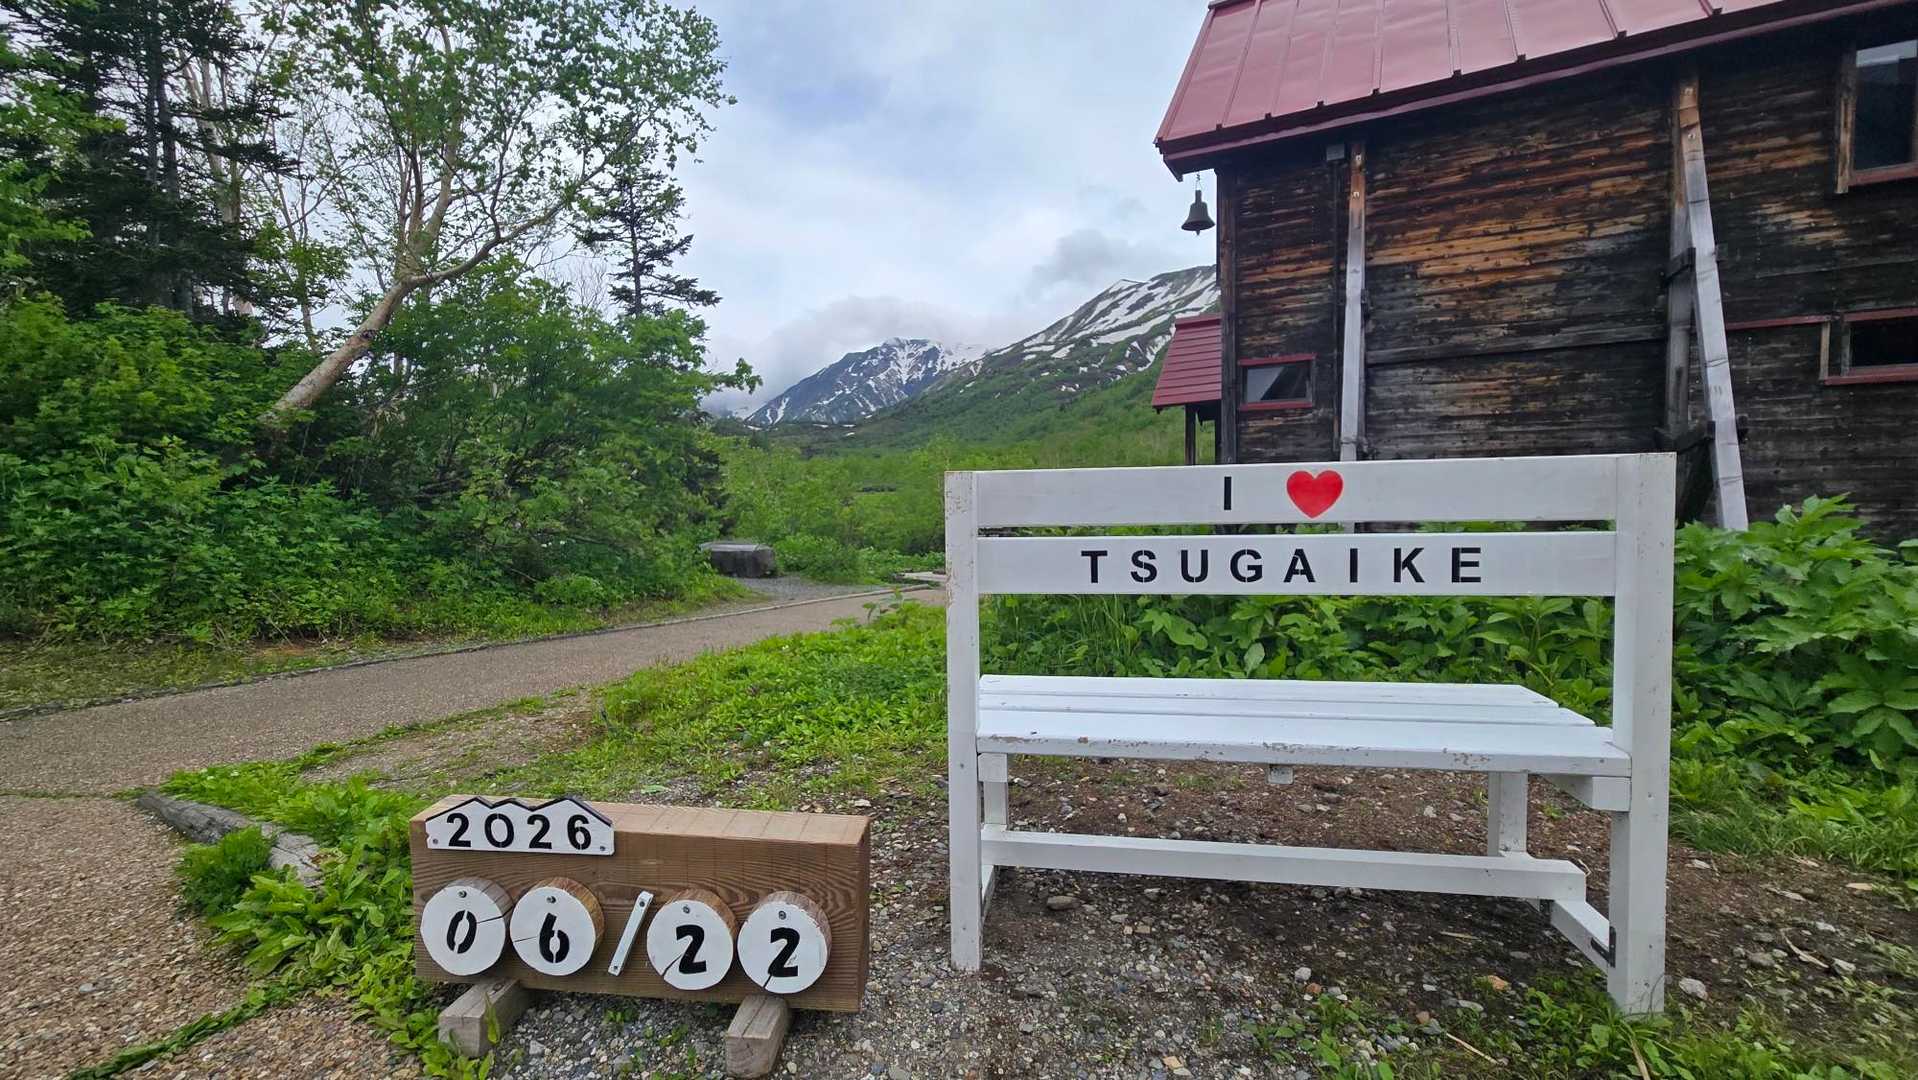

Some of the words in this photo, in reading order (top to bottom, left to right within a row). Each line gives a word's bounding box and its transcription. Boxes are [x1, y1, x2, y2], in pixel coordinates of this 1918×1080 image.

[1223, 476, 1232, 510] I
[1081, 547, 1481, 583] TSUGAIKE
[446, 812, 592, 850] 2026
